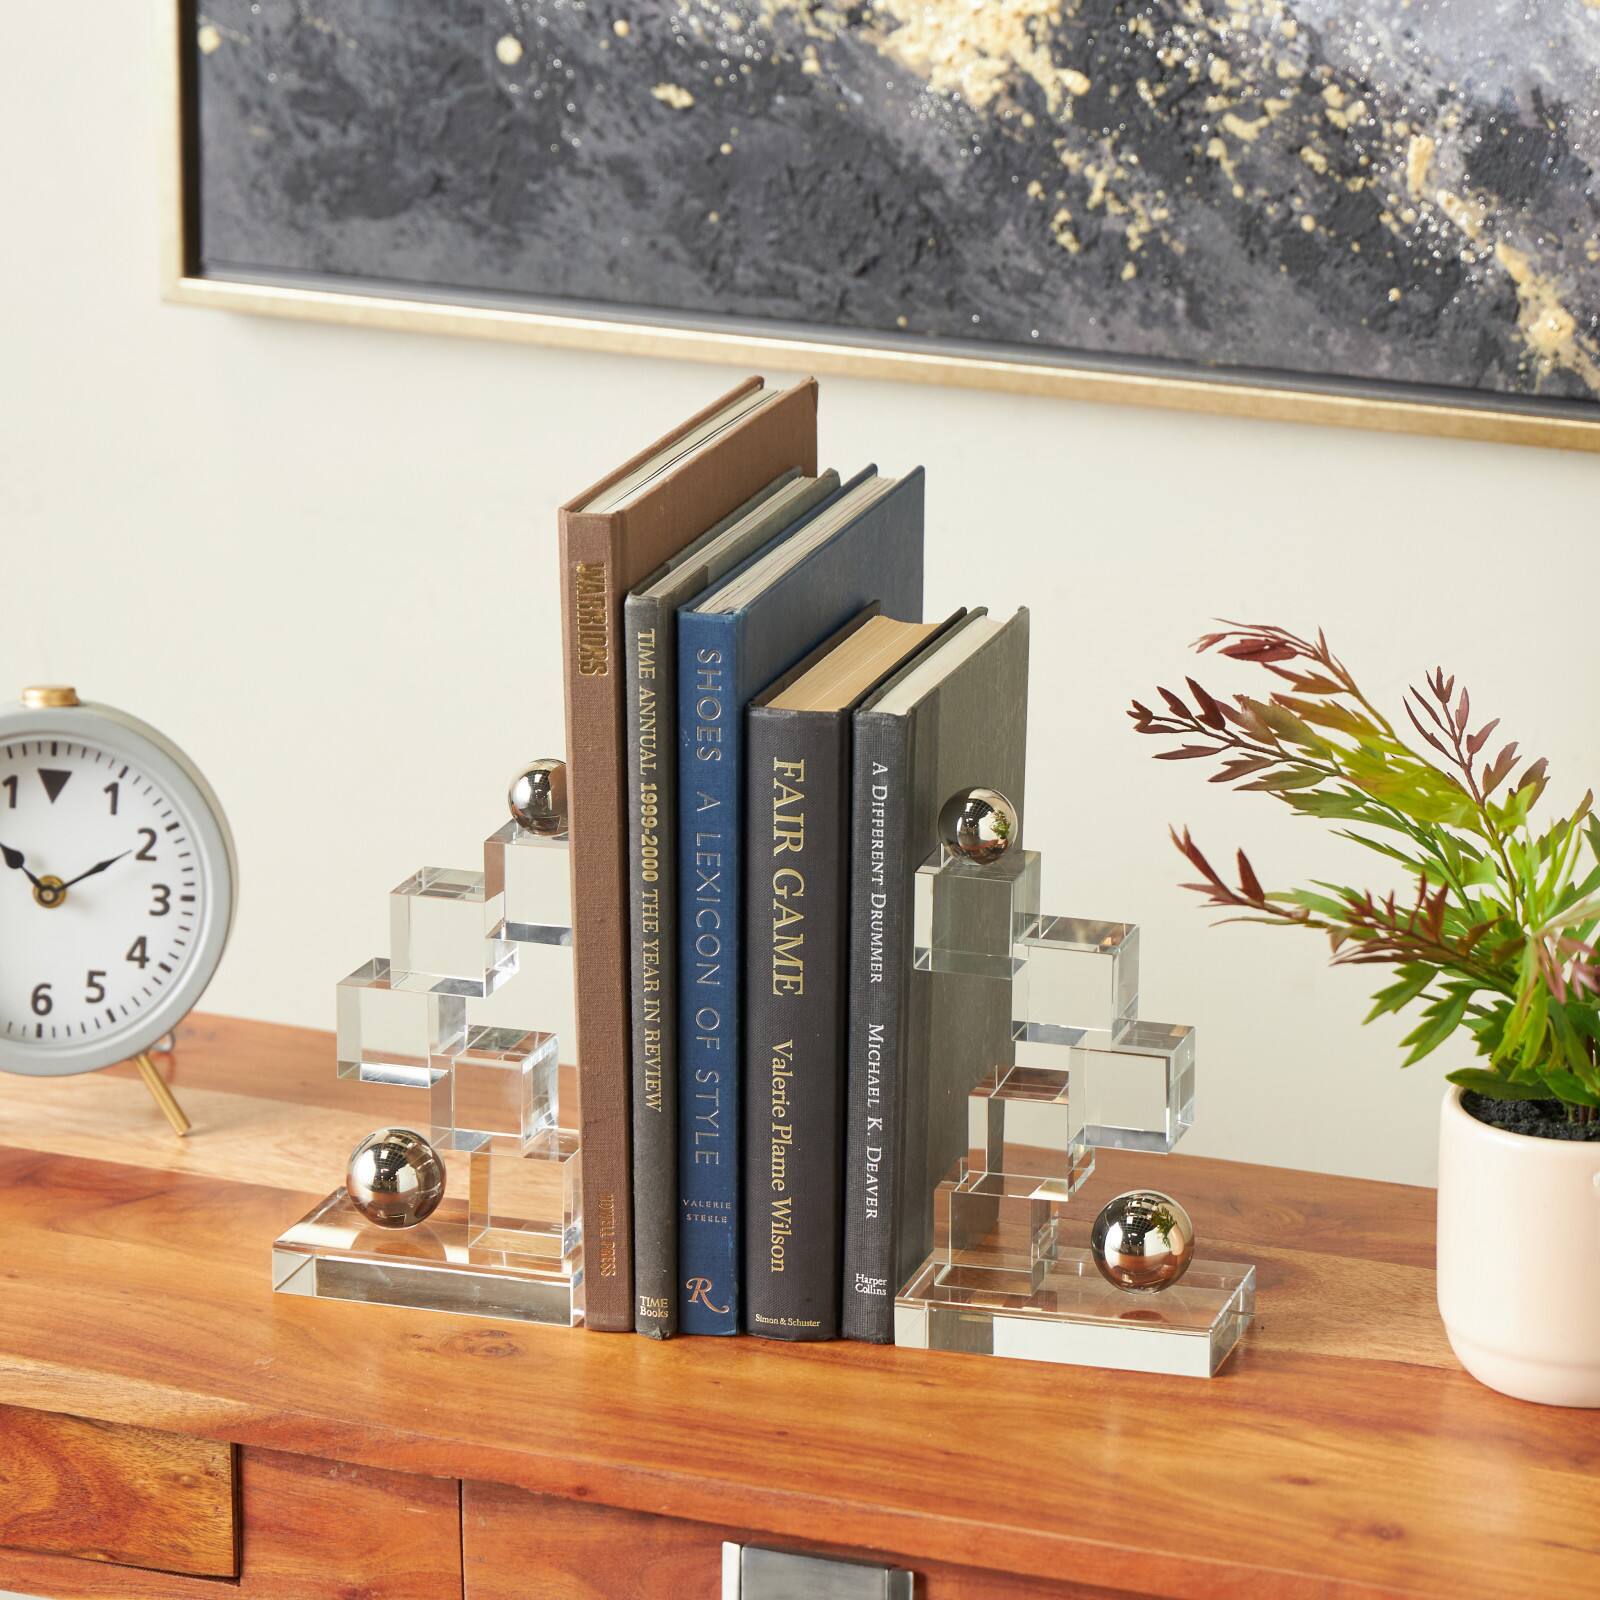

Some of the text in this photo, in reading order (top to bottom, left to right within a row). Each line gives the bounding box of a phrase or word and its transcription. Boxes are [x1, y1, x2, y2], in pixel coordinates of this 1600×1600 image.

[575, 561, 609, 677] WARRIORS
[103, 782, 119, 815] 1
[135, 828, 157, 861] 2
[637, 629, 661, 1113] TIME ANNUAL 1999-2000 THE YEAR IN REVIEW
[772, 757, 805, 998] FAIR GAME
[869, 761, 888, 983] A DIFFERENT DRUMMER
[149, 883, 171, 916] 3
[695, 649, 722, 1166] SHOES A LEXICON OF STYLE
[126, 936, 150, 969] 4
[31, 983, 53, 1015] 6
[85, 970, 107, 1003] 5
[866, 1023, 884, 1220] MICHAEL K. DEAVER
[771, 1039, 793, 1272] Valerie Plame Wilson
[682, 1199, 732, 1209] VALERIE
[686, 1213, 728, 1223] STEELE
[686, 1278, 729, 1313] R
[855, 1274, 887, 1287] Harper
[855, 1283, 887, 1296] Collins
[640, 1296, 668, 1308] TIME
[640, 1305, 669, 1318] Books
[755, 1313, 821, 1327] Simon & Schuster
